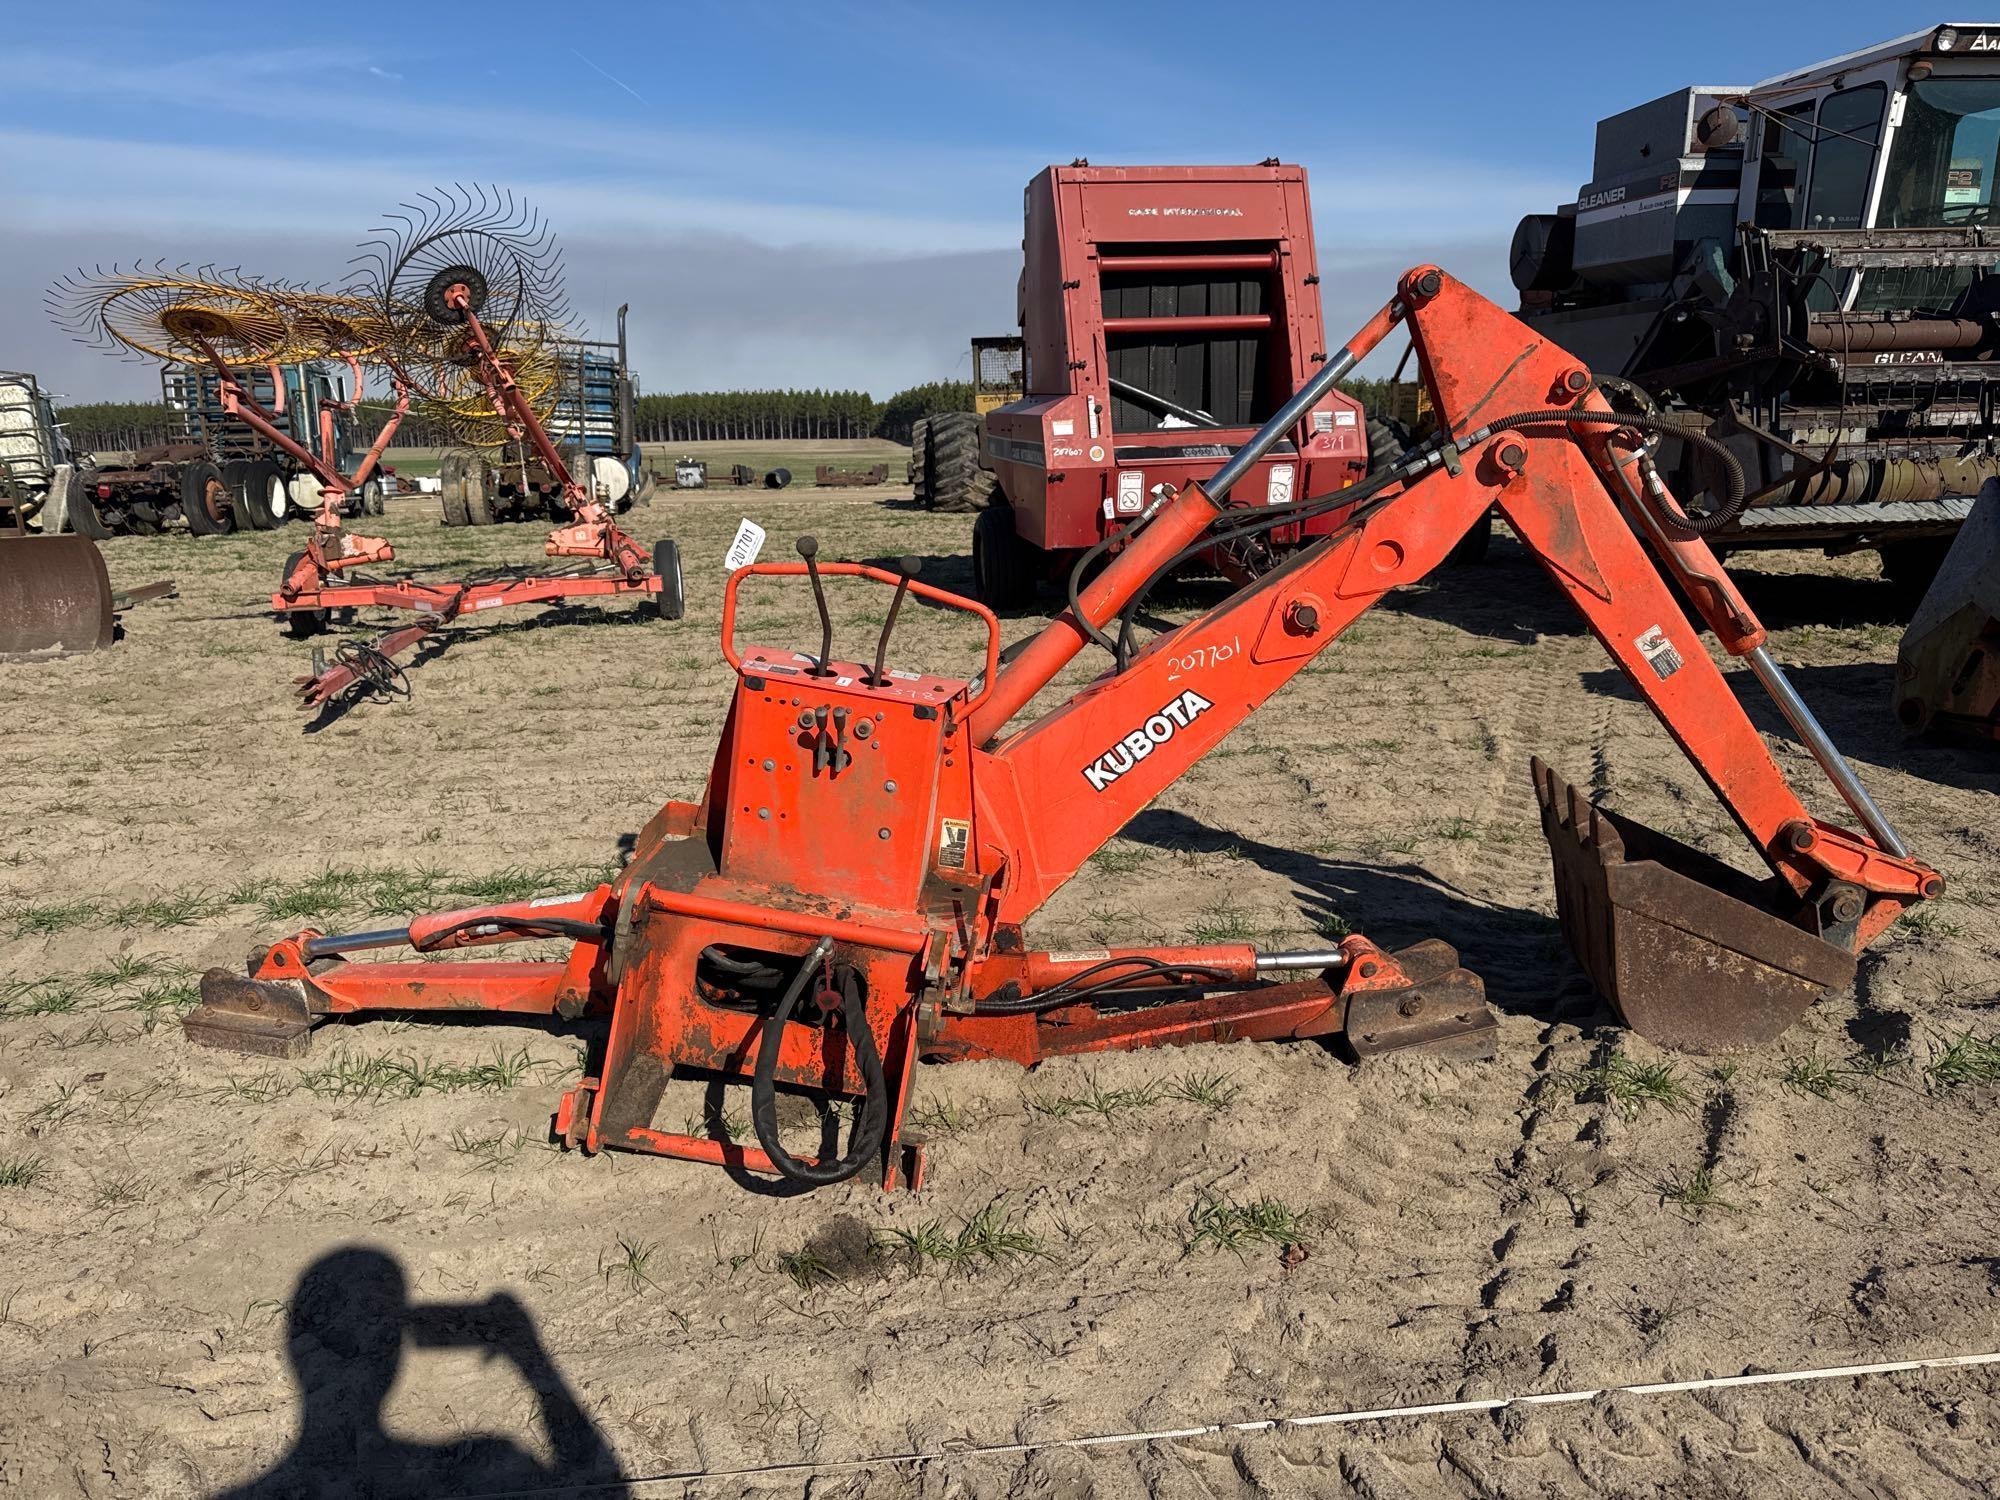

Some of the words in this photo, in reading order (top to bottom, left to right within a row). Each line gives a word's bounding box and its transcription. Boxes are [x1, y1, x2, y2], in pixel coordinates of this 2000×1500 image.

[1948, 171, 1973, 185] F2
[1578, 186, 1626, 211] GLEANER
[1128, 208, 1159, 216] CASE
[1163, 208, 1243, 216] INTERNATIONAL
[1053, 447, 1083, 457] 207607
[731, 528, 756, 566] 207701
[1167, 635, 1241, 682] 207701
[1081, 688, 1215, 792] KUBOTA
